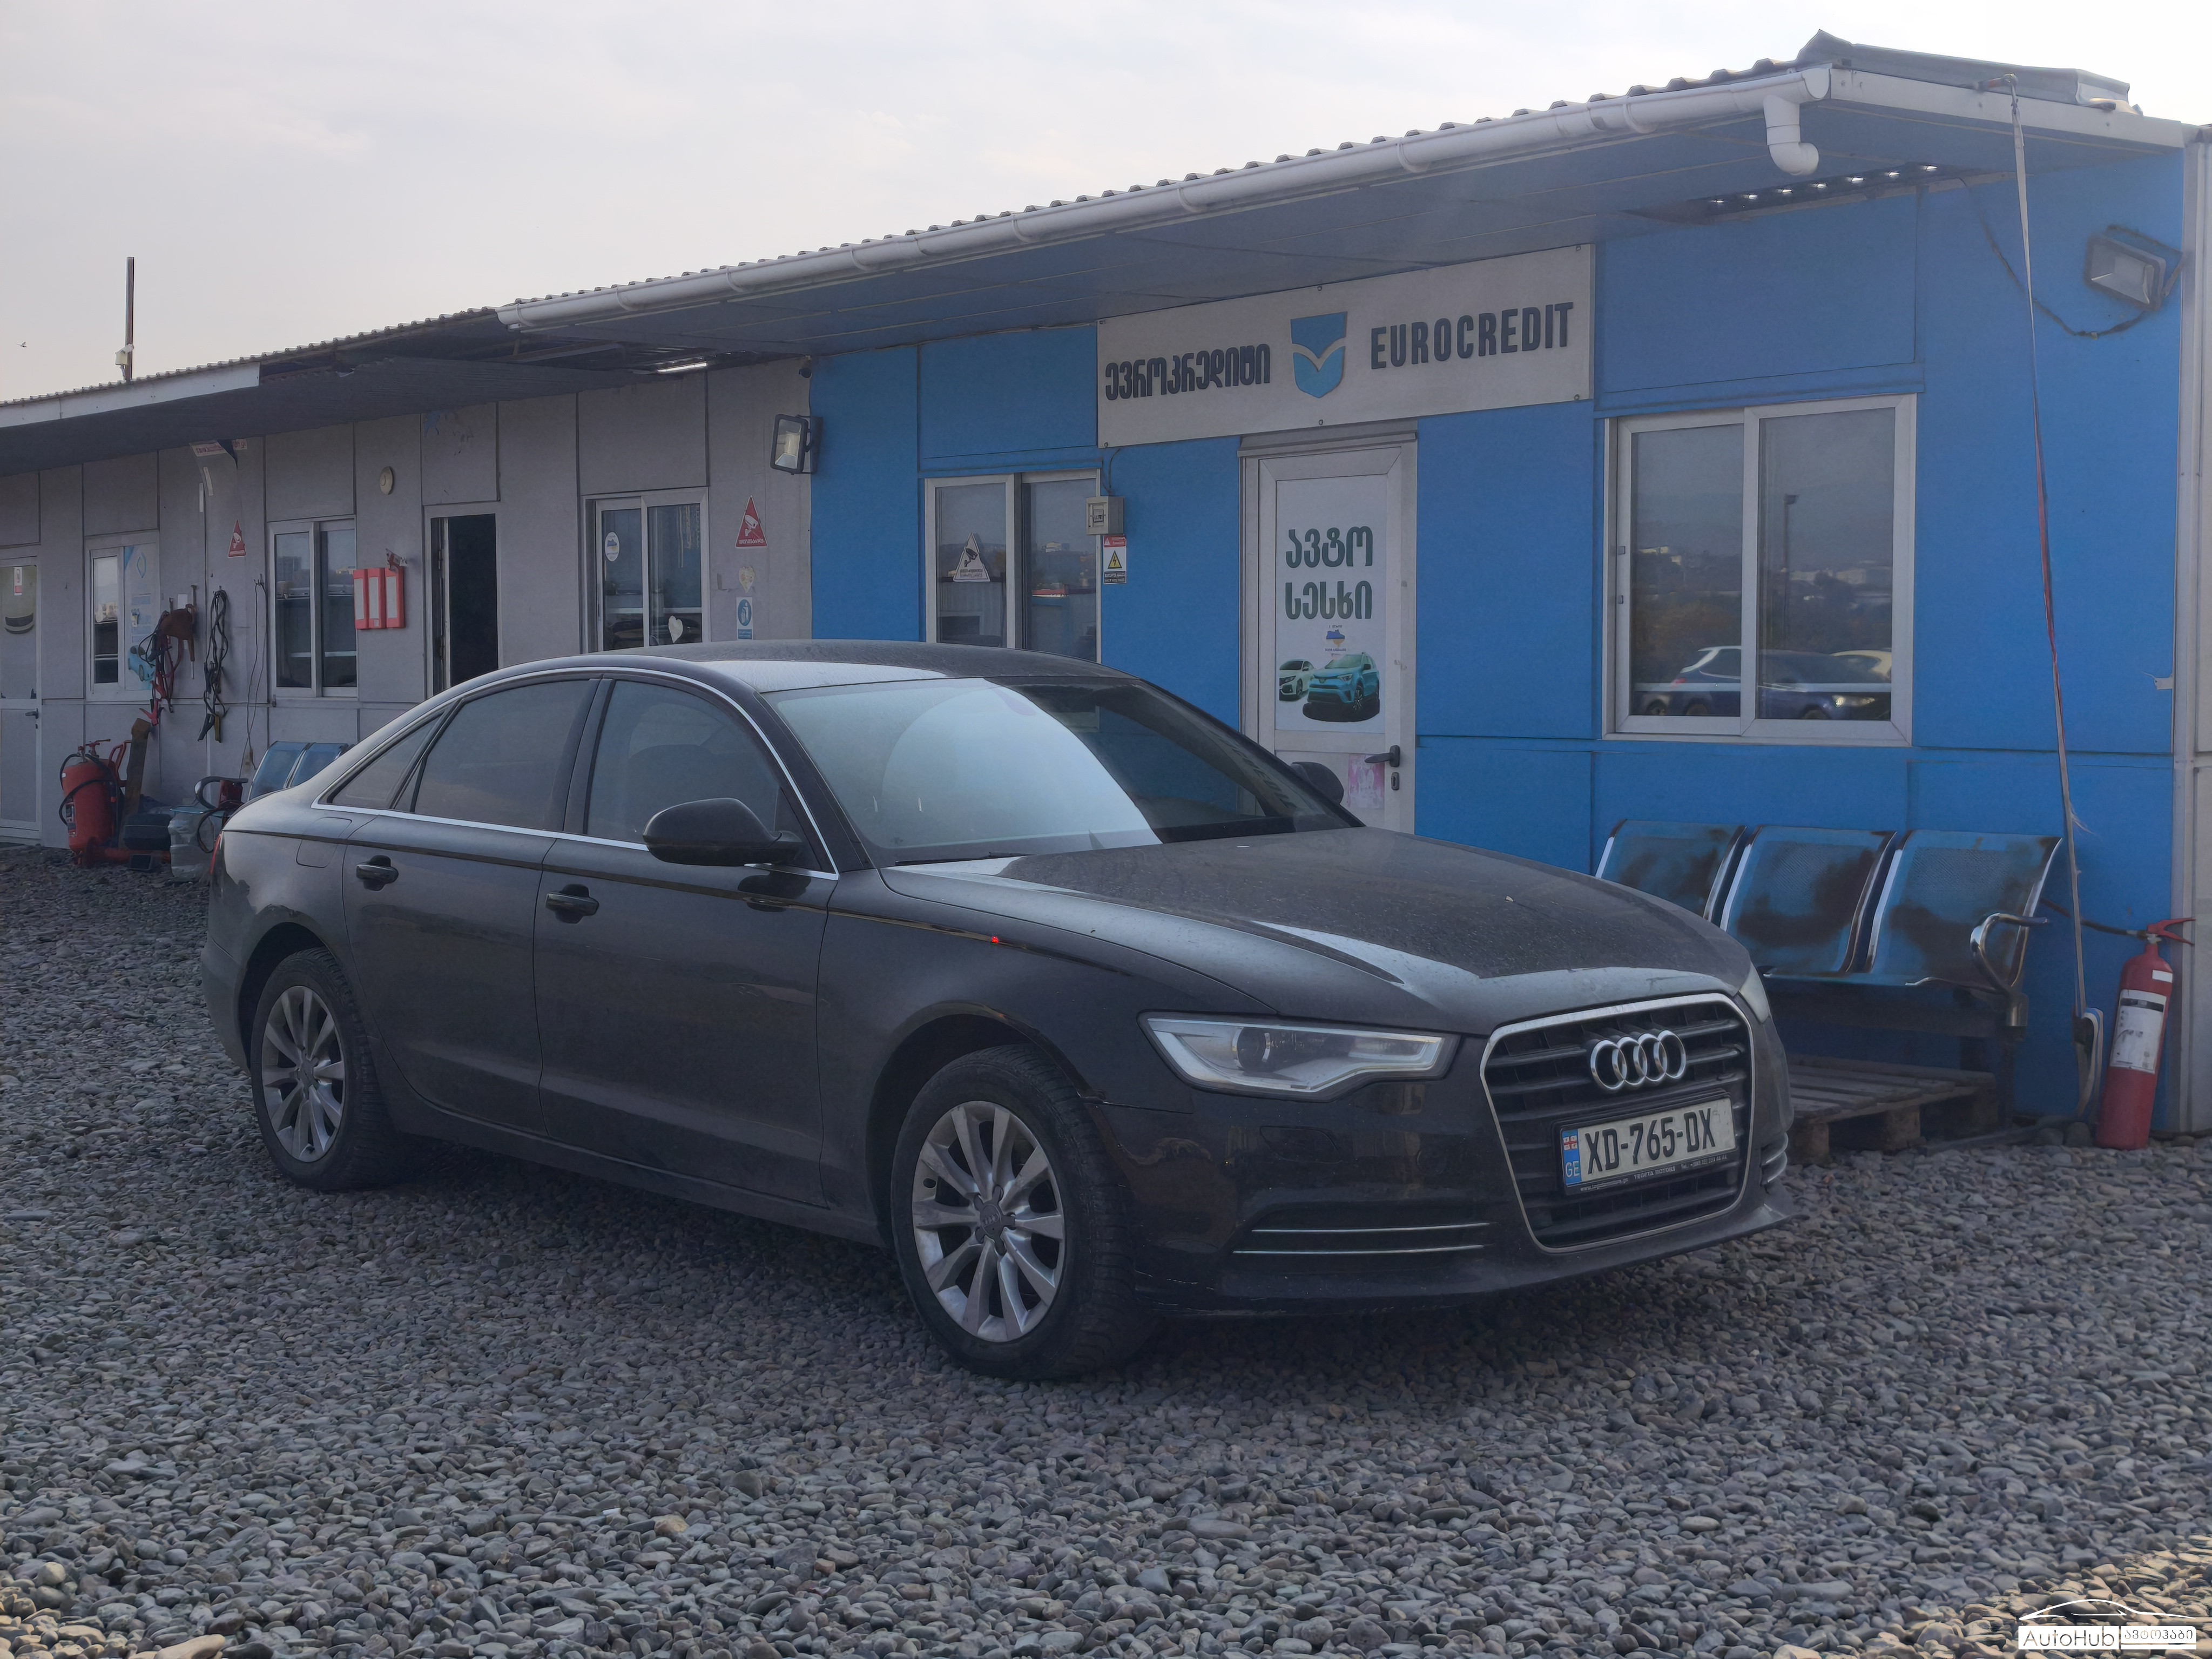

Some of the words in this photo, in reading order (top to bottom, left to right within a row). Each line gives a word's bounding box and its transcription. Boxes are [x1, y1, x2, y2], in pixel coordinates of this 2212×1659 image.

[1371, 301, 1574, 370] EUROCREDIT
[1105, 343, 1271, 401] ევროკრედიტი
[1285, 525, 1373, 568] ავტო
[1285, 580, 1372, 620] სესხი
[1584, 1108, 1716, 1175] XD-765-DX
[1566, 1161, 1581, 1178] GE
